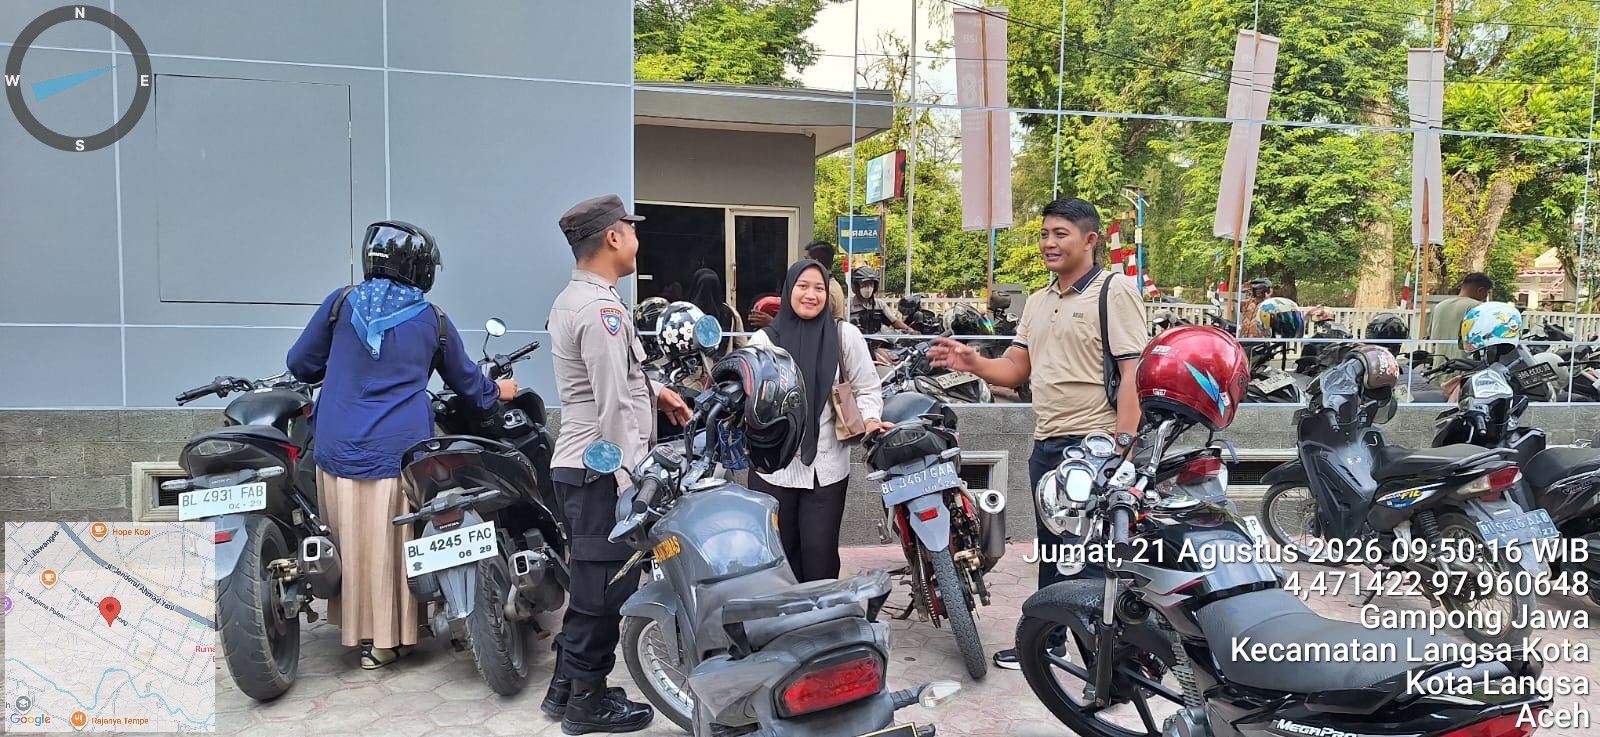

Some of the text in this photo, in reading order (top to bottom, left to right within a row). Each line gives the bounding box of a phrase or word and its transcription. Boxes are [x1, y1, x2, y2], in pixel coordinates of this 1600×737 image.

[929, 463, 955, 478] GAA
[182, 485, 264, 507] BL 4931 FAB
[408, 527, 492, 558] BL 4245 FAC
[458, 544, 492, 559] 06 29
